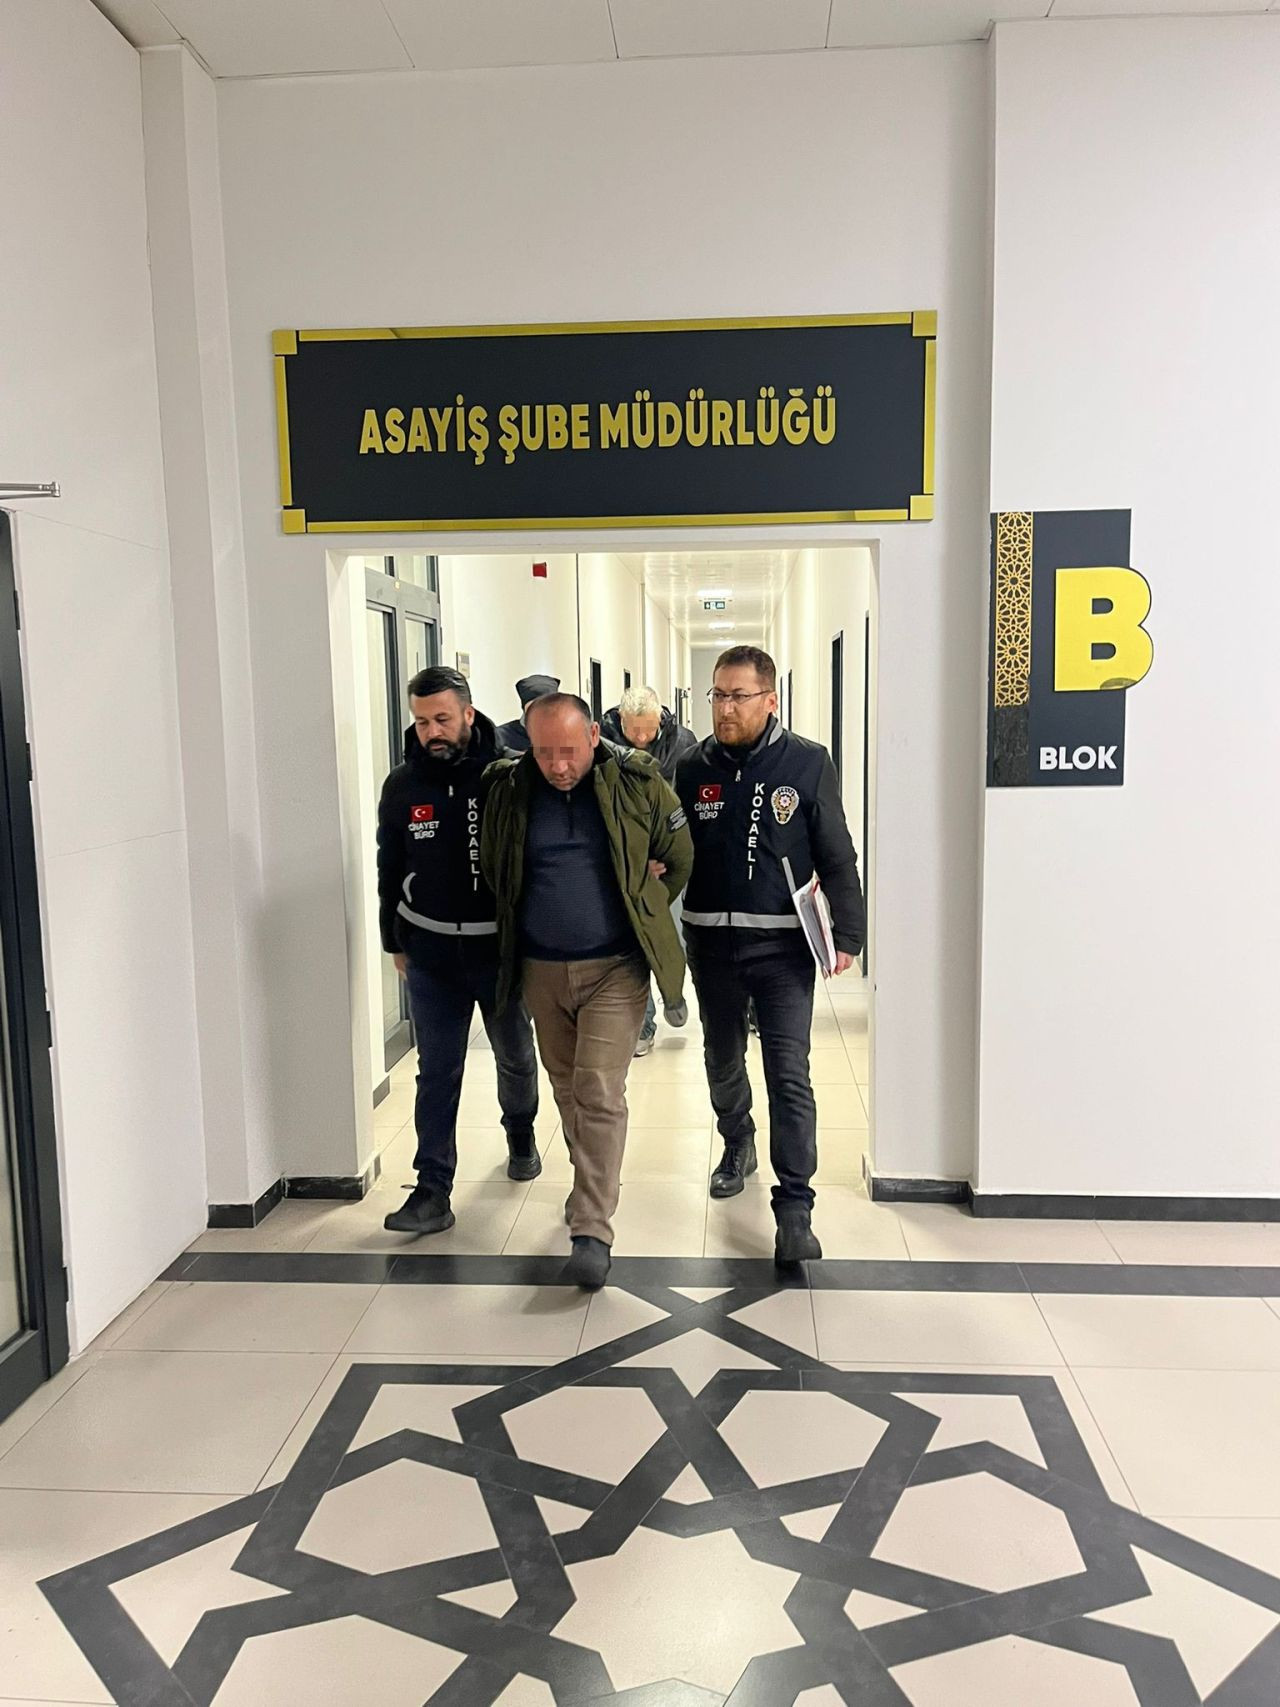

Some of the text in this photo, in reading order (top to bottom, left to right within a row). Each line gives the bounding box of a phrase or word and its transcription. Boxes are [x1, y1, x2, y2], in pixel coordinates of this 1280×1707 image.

[359, 384, 837, 465] ASAYİŞ ŞUBE MÜDÜRLÜĞÜ
[1053, 566, 1154, 692] B
[1039, 745, 1118, 771] BLOK
